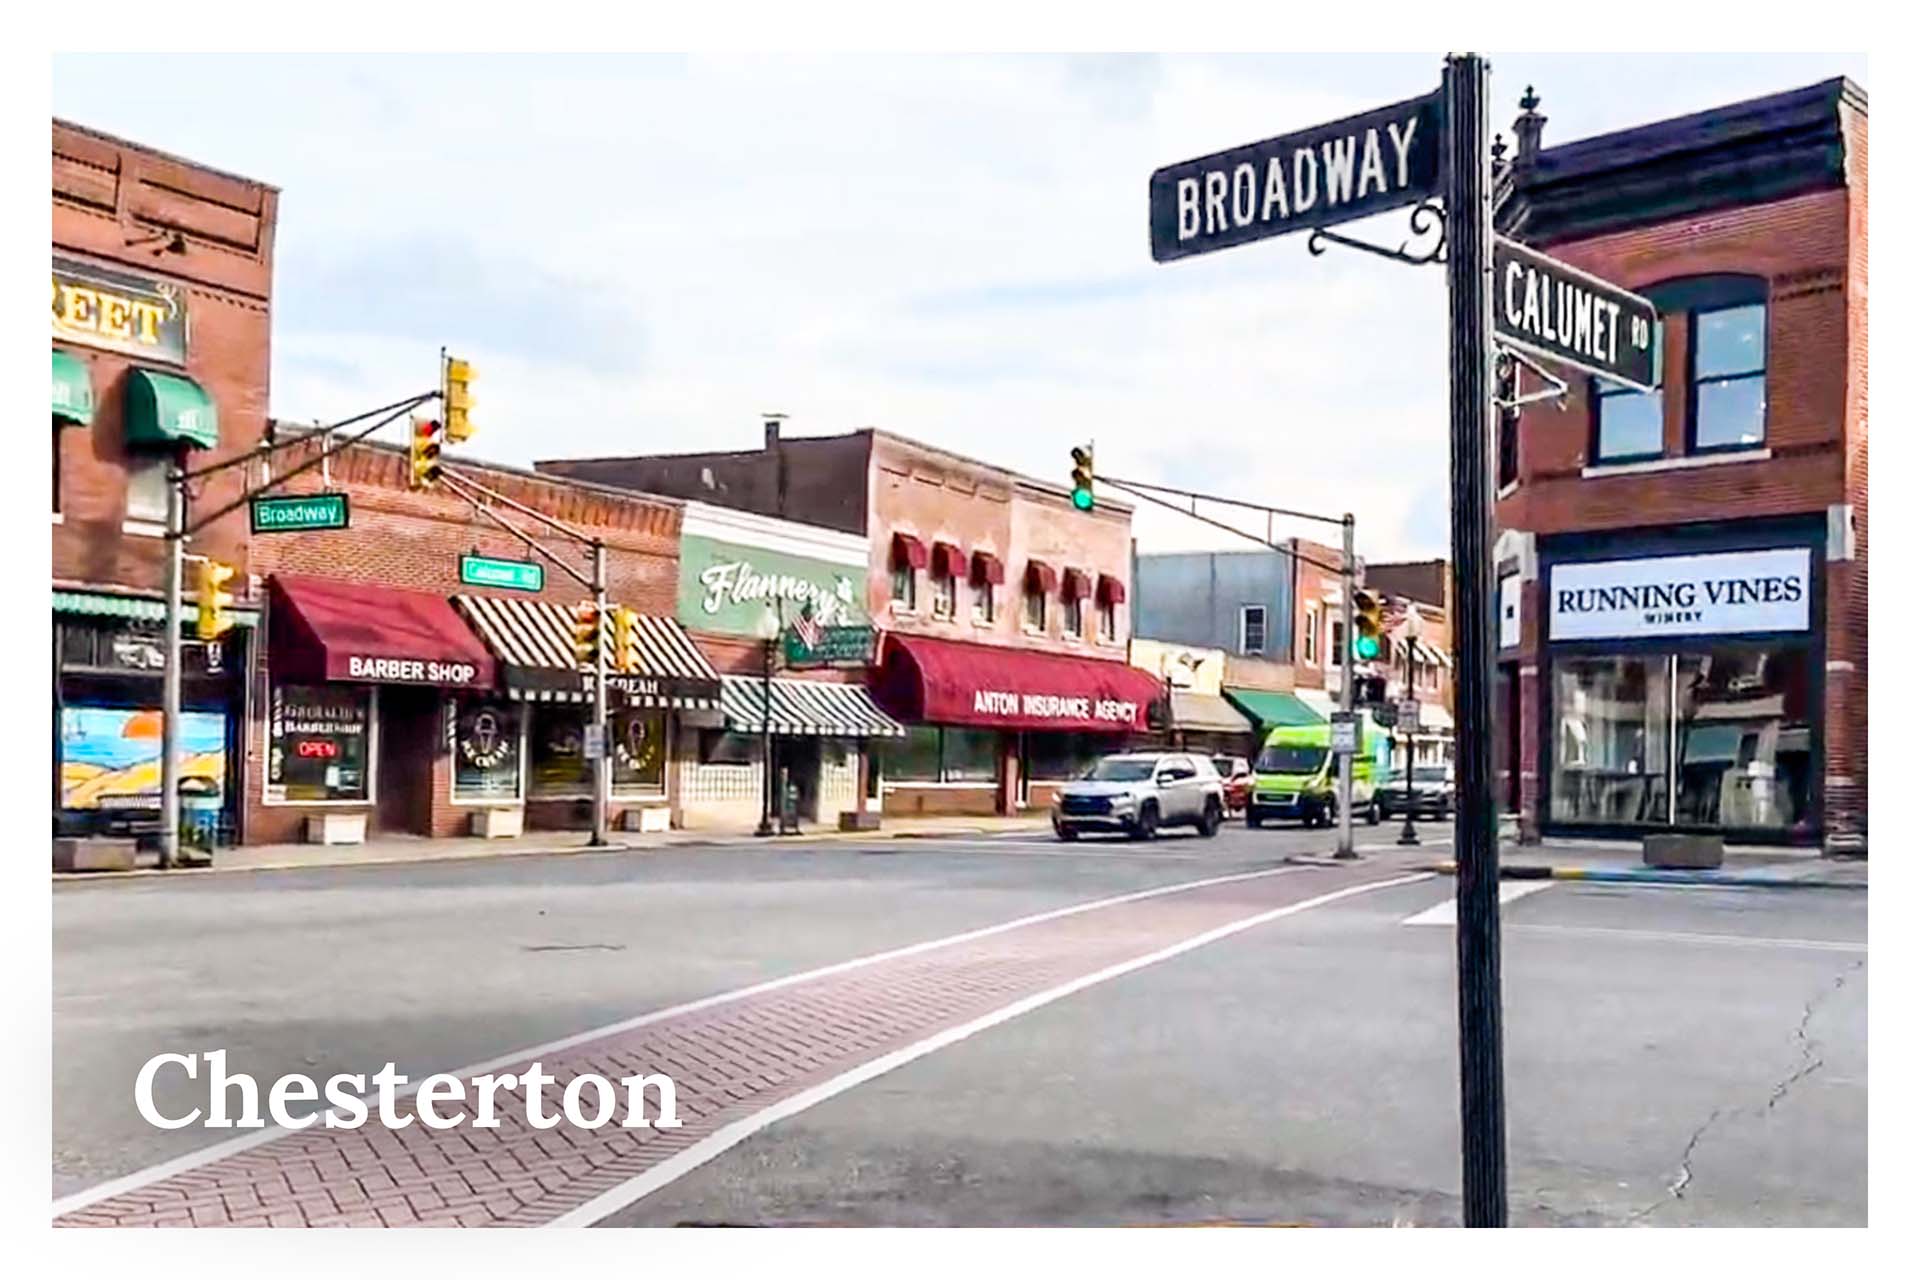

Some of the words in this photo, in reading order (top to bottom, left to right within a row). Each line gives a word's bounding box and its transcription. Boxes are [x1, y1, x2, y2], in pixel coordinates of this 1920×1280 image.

[1178, 117, 1418, 241] BROADWAY
[1505, 260, 1620, 365] CALUMET
[1631, 315, 1649, 350] RD
[258, 505, 337, 524] Broadway
[1557, 583, 1697, 613] RUNNING
[1703, 576, 1802, 605] VINES
[1644, 611, 1703, 625] WINERY
[349, 657, 424, 680] BARBER
[427, 661, 475, 683] SHOP
[974, 690, 1019, 715] ANTON
[1022, 694, 1090, 721] INSURANCE
[1094, 699, 1137, 724] AGENCY
[299, 741, 337, 757] OPEN
